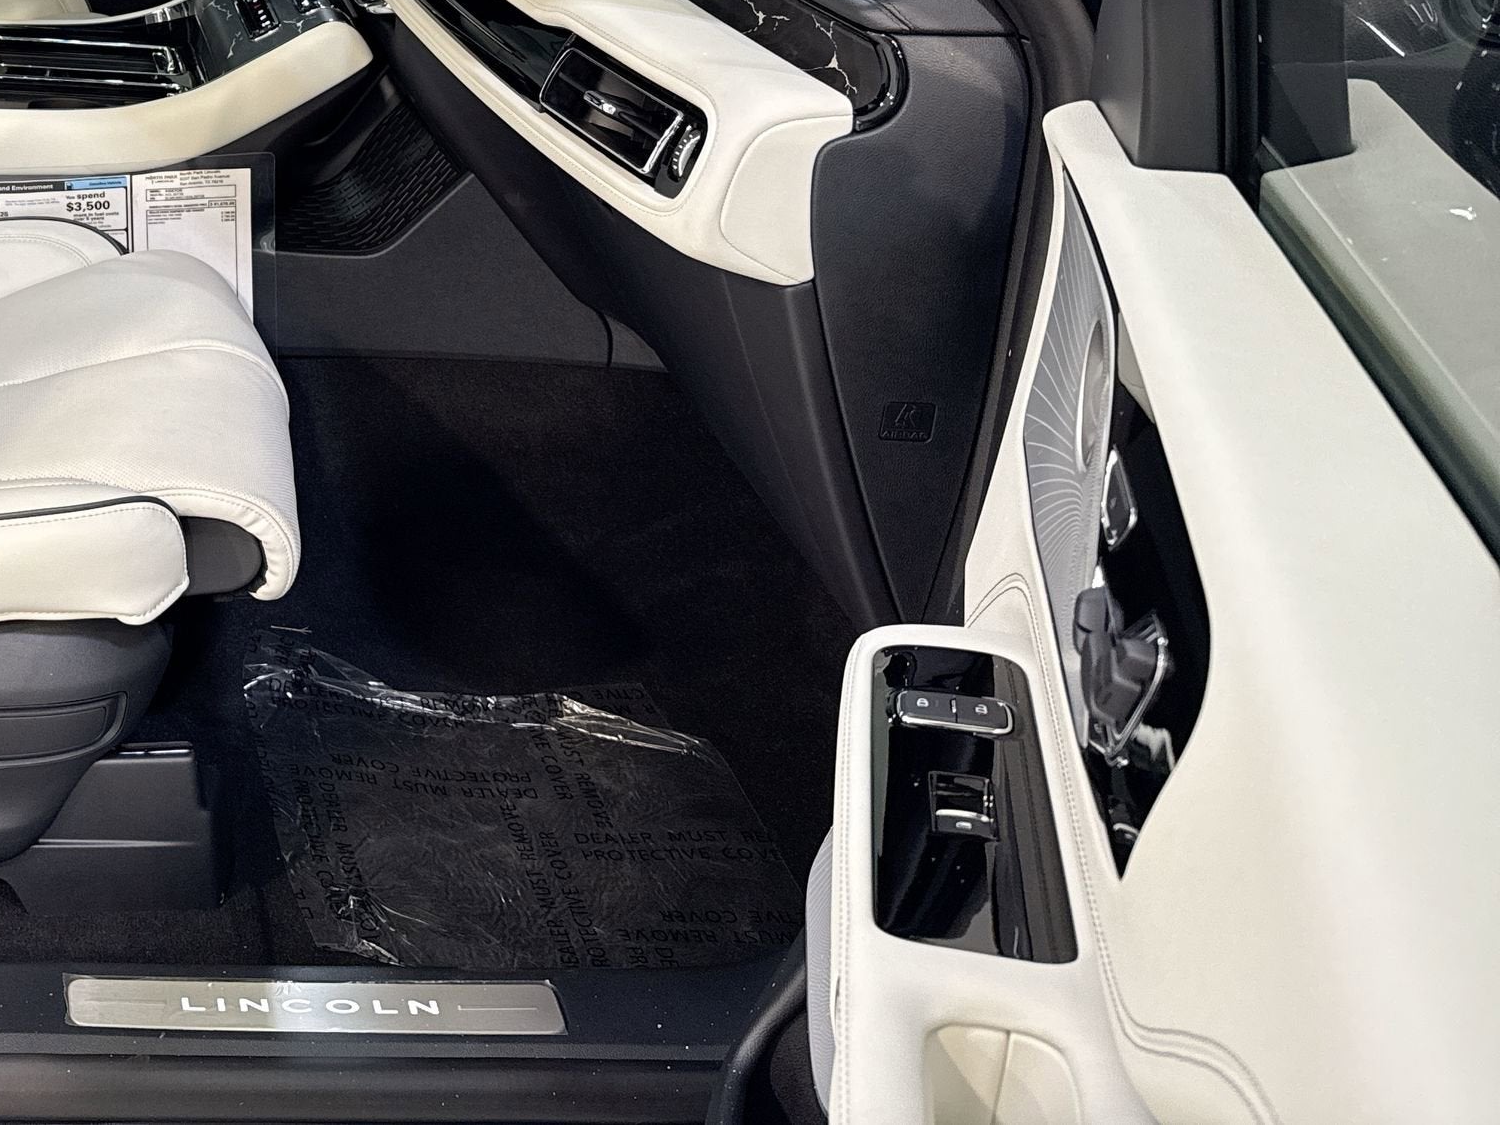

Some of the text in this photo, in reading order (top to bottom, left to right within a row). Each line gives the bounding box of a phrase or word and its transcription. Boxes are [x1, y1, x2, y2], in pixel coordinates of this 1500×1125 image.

[12, 183, 54, 191] Environment
[77, 191, 105, 201] spend
[66, 200, 111, 213] $3,500
[330, 753, 533, 784] PROTECTIVE COVER
[289, 763, 539, 800] DEALER MUST REMOVE
[542, 756, 574, 801] COVER
[500, 799, 538, 861] REMOVE
[574, 831, 654, 845] DEALER
[667, 829, 728, 843] MUST
[582, 847, 712, 862] PROTECTIVE
[525, 869, 556, 911] MUST
[538, 831, 612, 968] ROTECTIVE COVER
[659, 909, 737, 924] COVER
[616, 928, 718, 944] REMOVE
[181, 996, 440, 1015] LINCOLN
